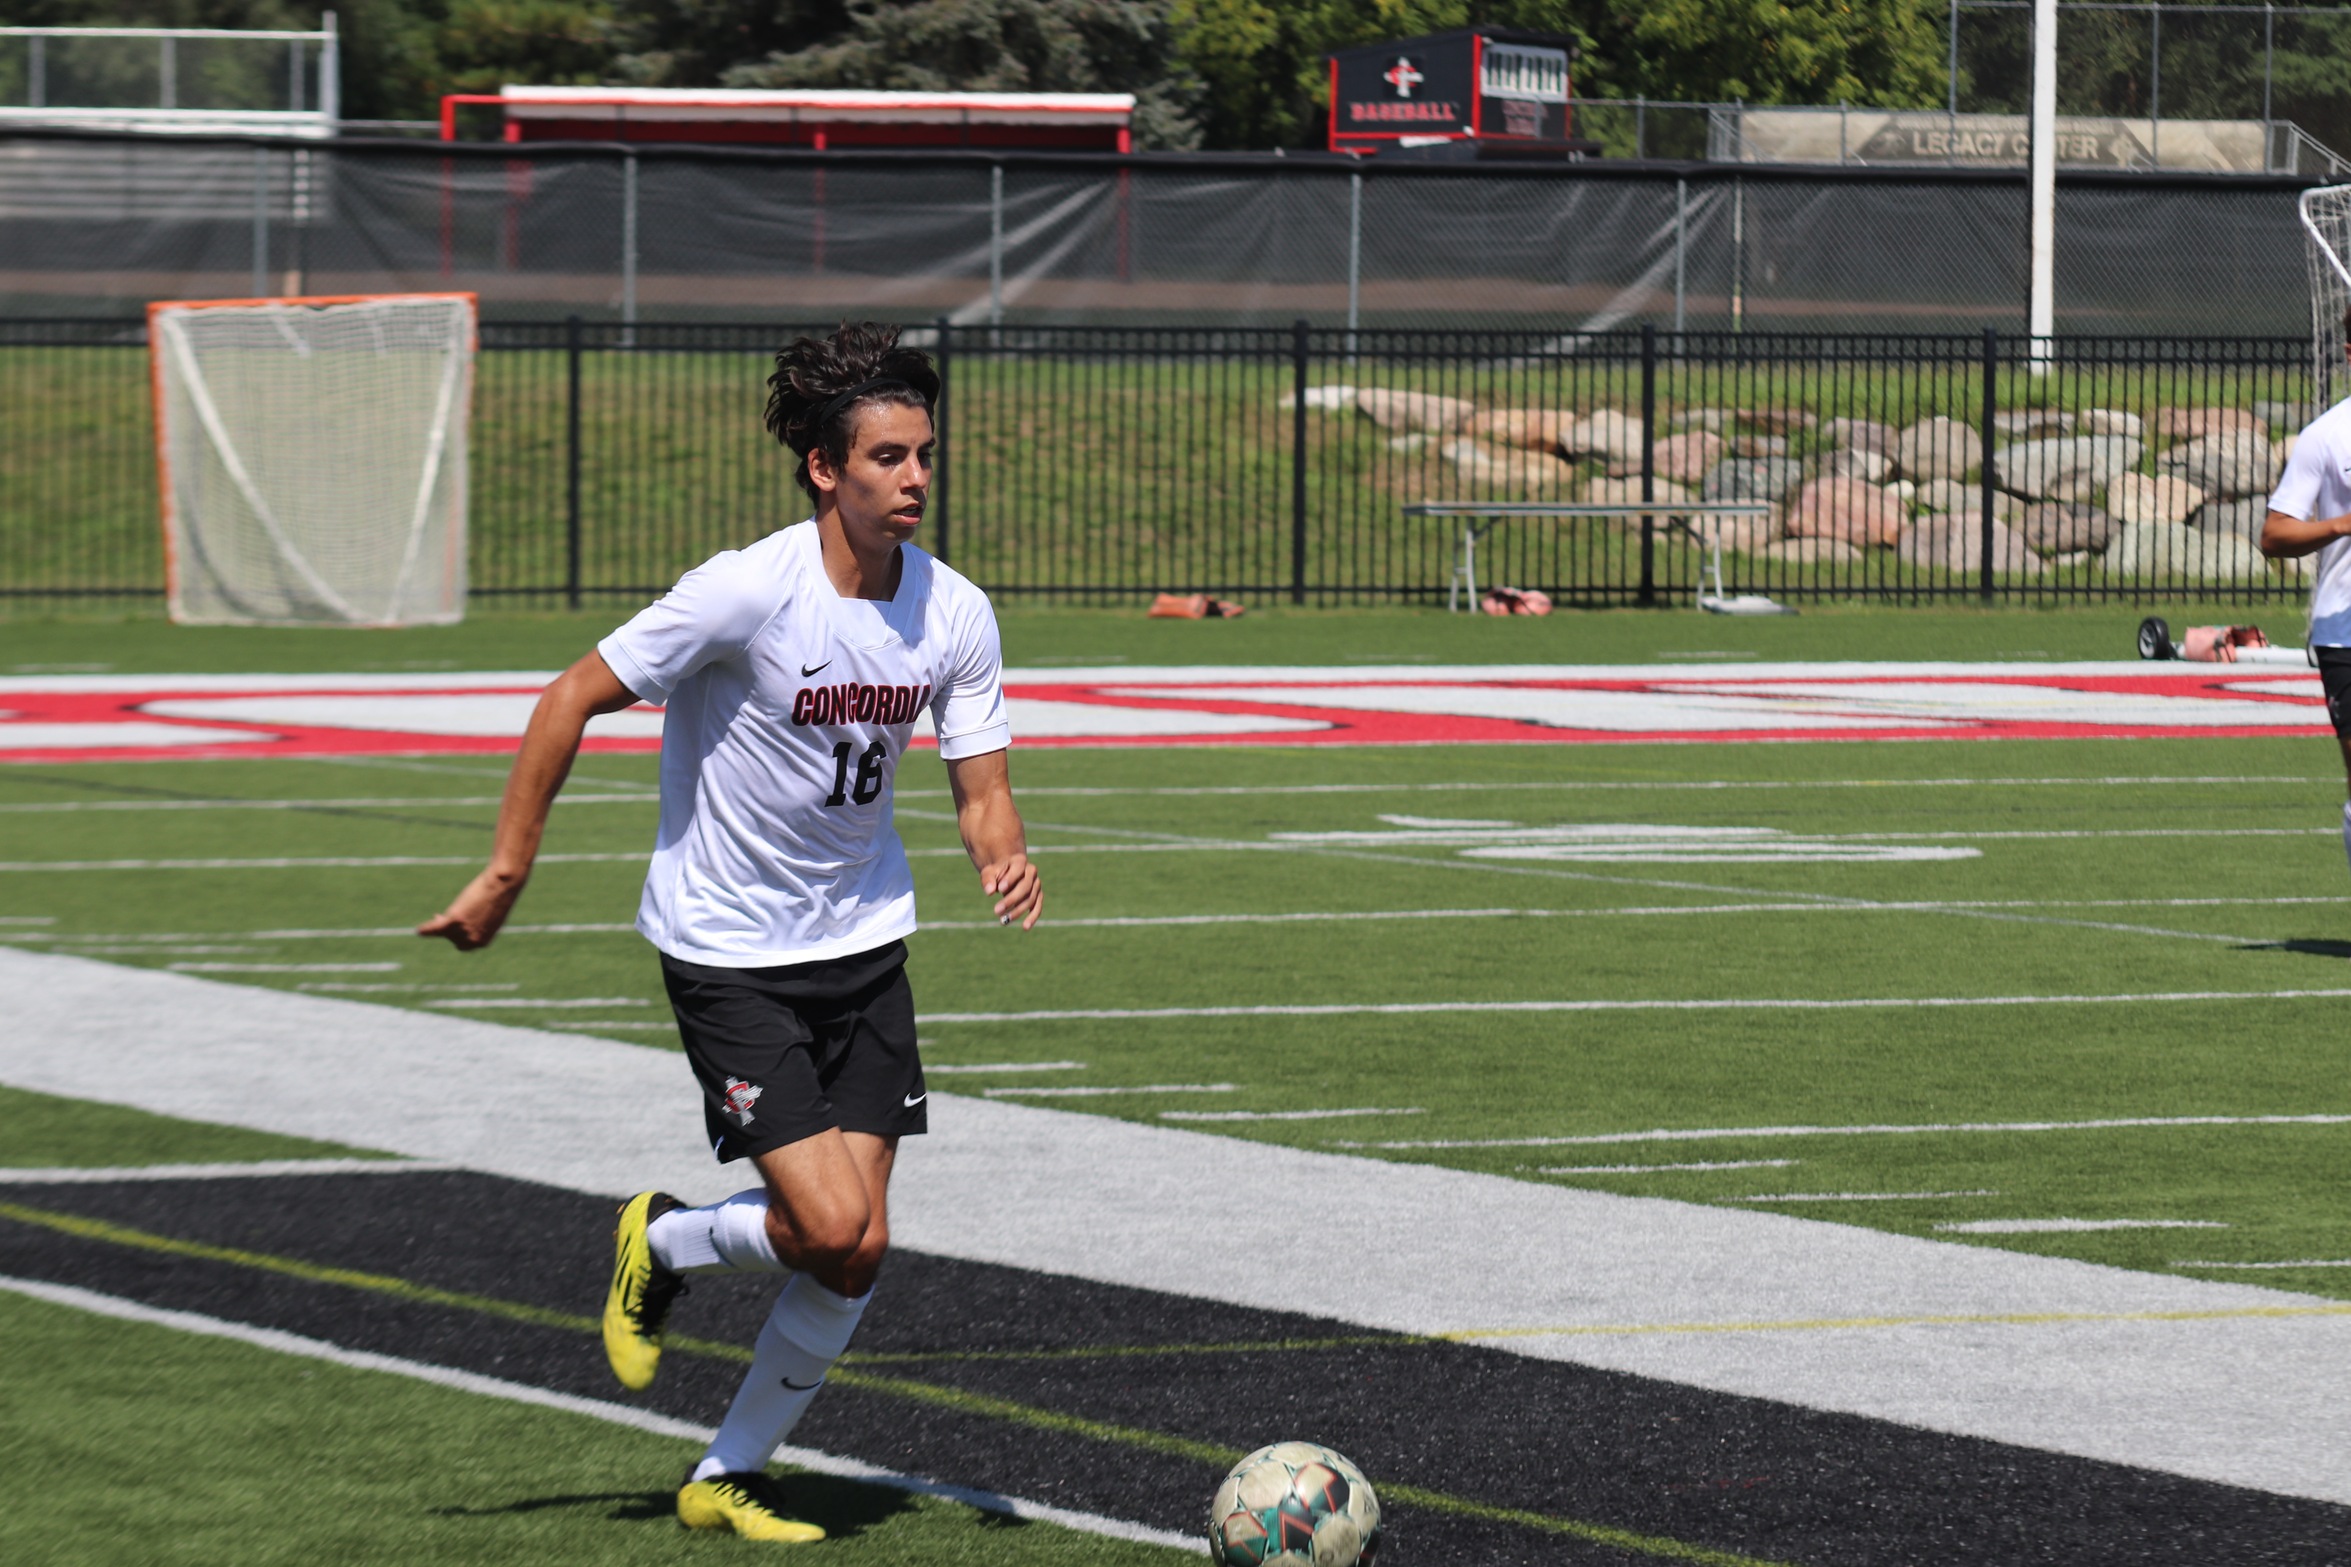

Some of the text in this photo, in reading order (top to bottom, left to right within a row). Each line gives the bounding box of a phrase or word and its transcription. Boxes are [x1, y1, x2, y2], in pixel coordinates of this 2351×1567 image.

[1350, 101, 1456, 121] BASEBALL
[1912, 130, 2099, 160] LEGACY CTER
[824, 740, 887, 807] 16
